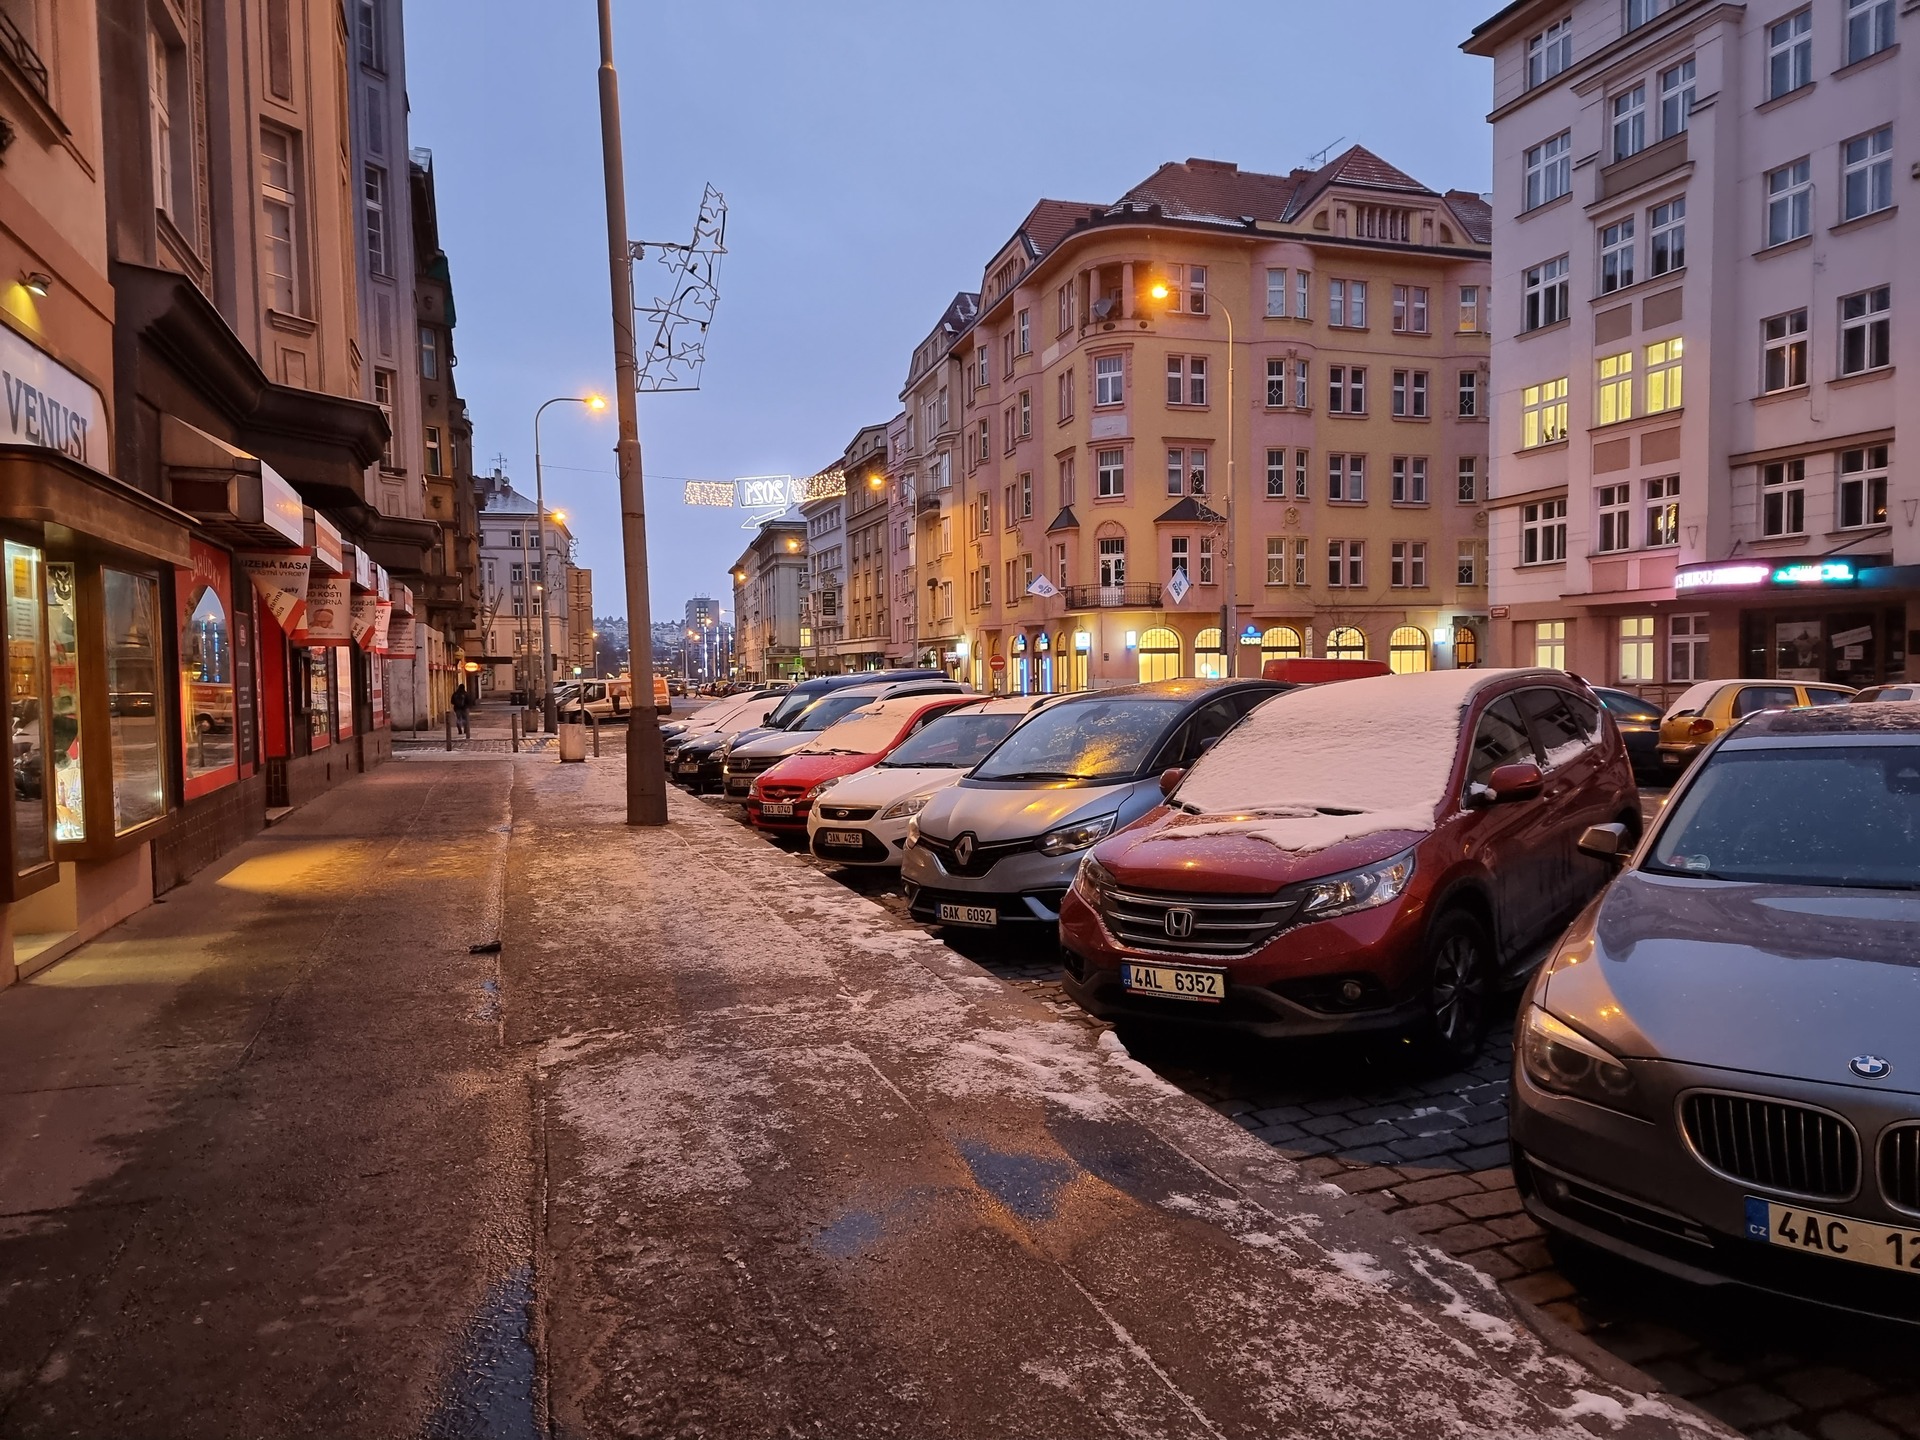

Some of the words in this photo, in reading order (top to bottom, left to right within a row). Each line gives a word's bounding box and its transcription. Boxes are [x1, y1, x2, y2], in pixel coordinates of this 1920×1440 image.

[279, 561, 309, 570] MASA
[1240, 636, 1262, 645] ČSOB
[843, 833, 861, 844] 4256
[942, 905, 960, 920] 6AK
[966, 908, 993, 923] 6092
[1135, 968, 1163, 989] 4AL
[1175, 973, 1217, 995] 6352
[1749, 1224, 1768, 1236] CZ
[1777, 1211, 1850, 1254] 4AC
